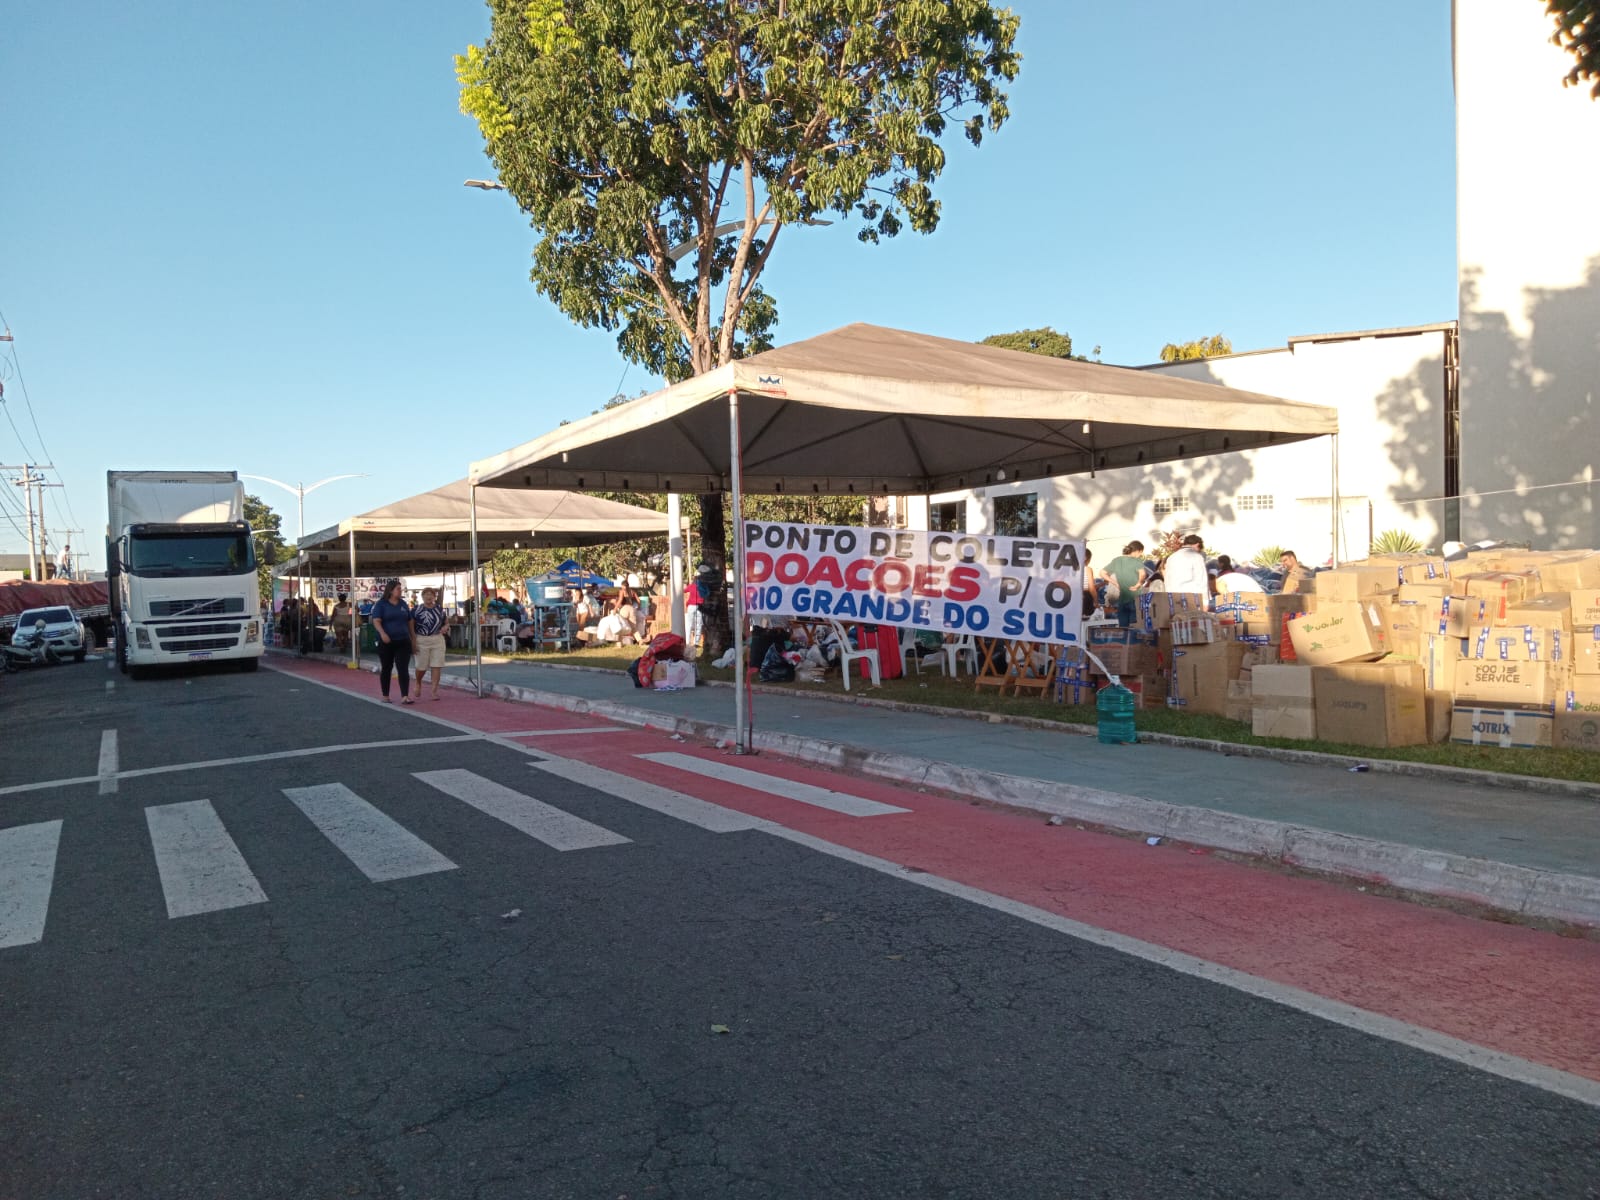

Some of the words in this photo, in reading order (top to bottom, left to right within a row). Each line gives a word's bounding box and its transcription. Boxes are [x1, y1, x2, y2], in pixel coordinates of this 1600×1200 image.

[746, 524, 857, 554] PONTO
[869, 531, 915, 558] DE
[930, 535, 1080, 571] COLETA
[747, 551, 981, 602] DOAÇÕES
[746, 586, 783, 611] RIO
[792, 587, 931, 625] GRANDE
[943, 602, 990, 631] DO
[1002, 609, 1077, 641] SUL
[1475, 673, 1520, 683] SERVICE
